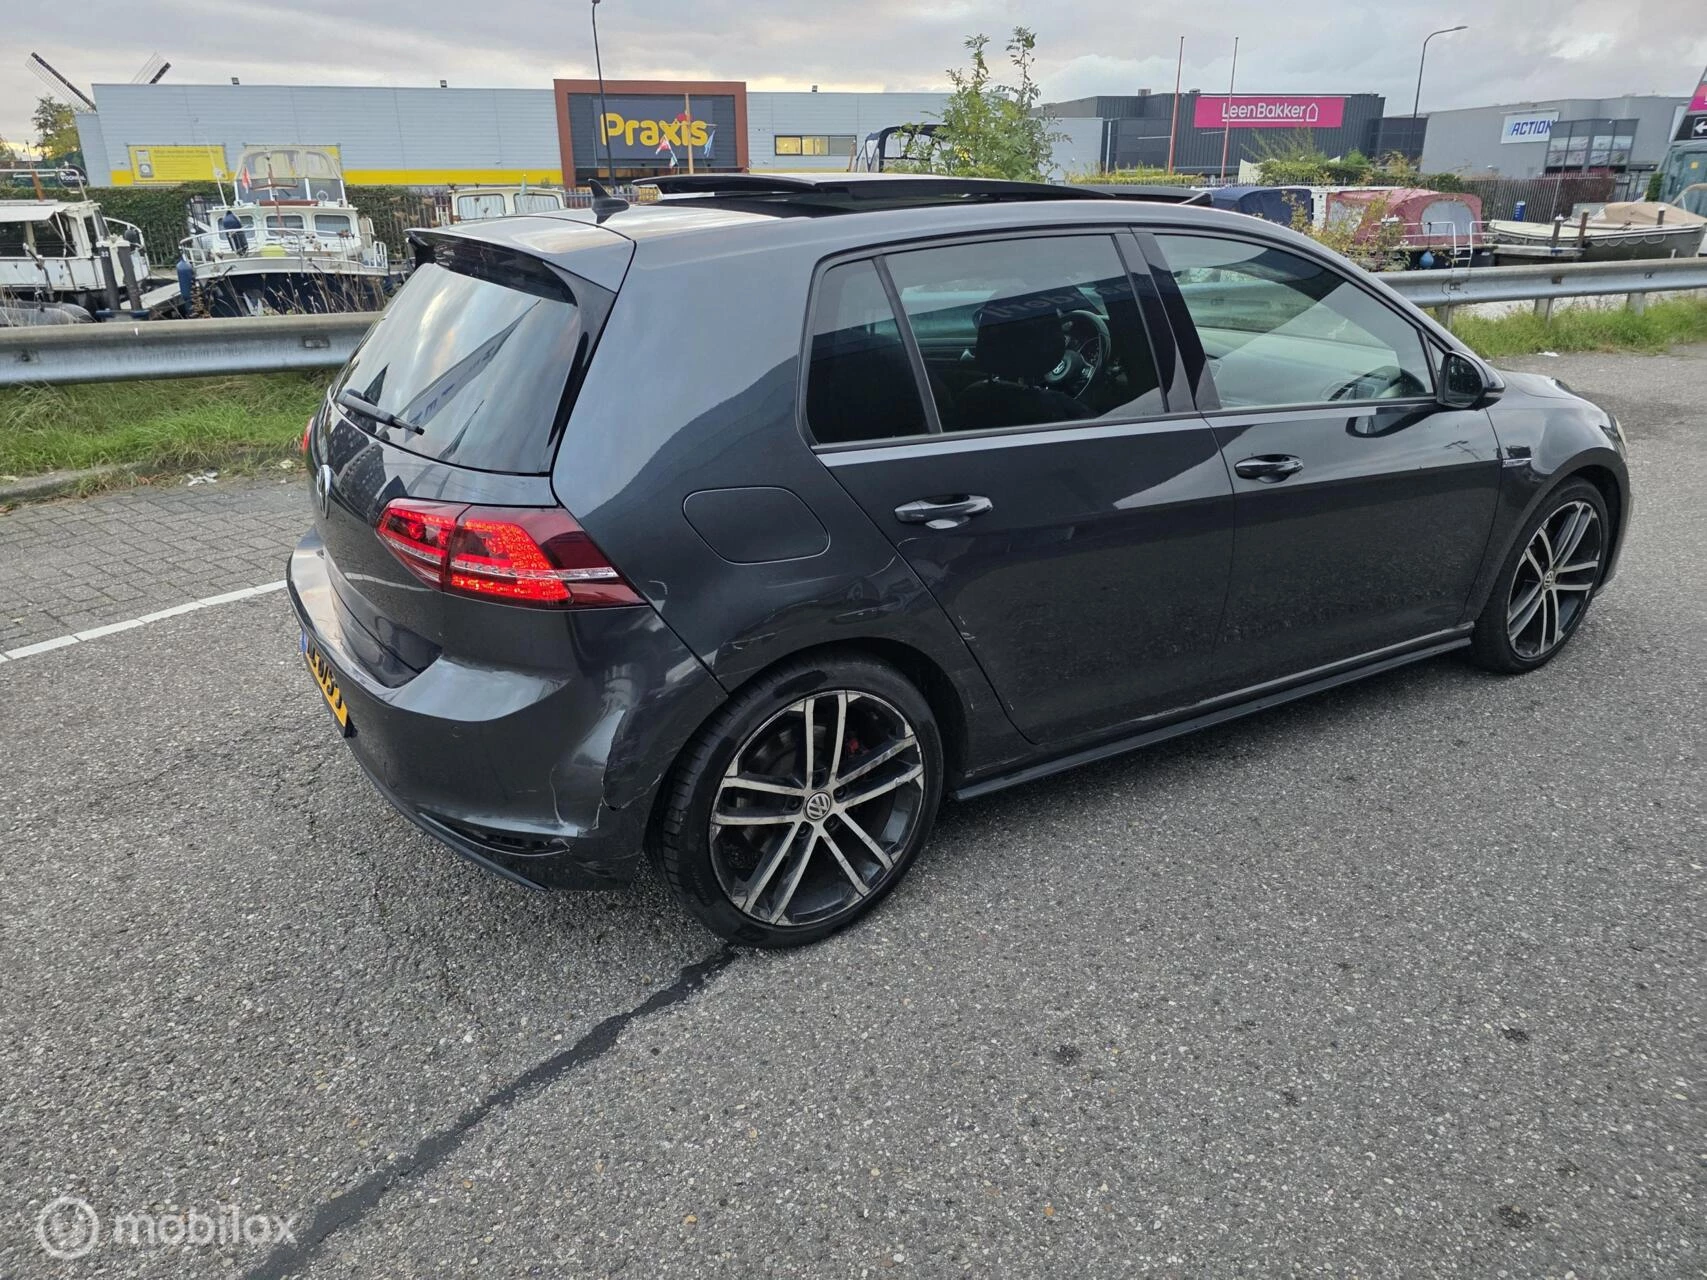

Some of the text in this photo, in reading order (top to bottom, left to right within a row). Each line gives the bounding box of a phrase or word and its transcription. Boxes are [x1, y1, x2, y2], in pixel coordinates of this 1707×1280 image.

[1222, 102, 1306, 118] LeenBakker
[600, 112, 709, 146] Praxis
[1511, 120, 1553, 136] ACTION
